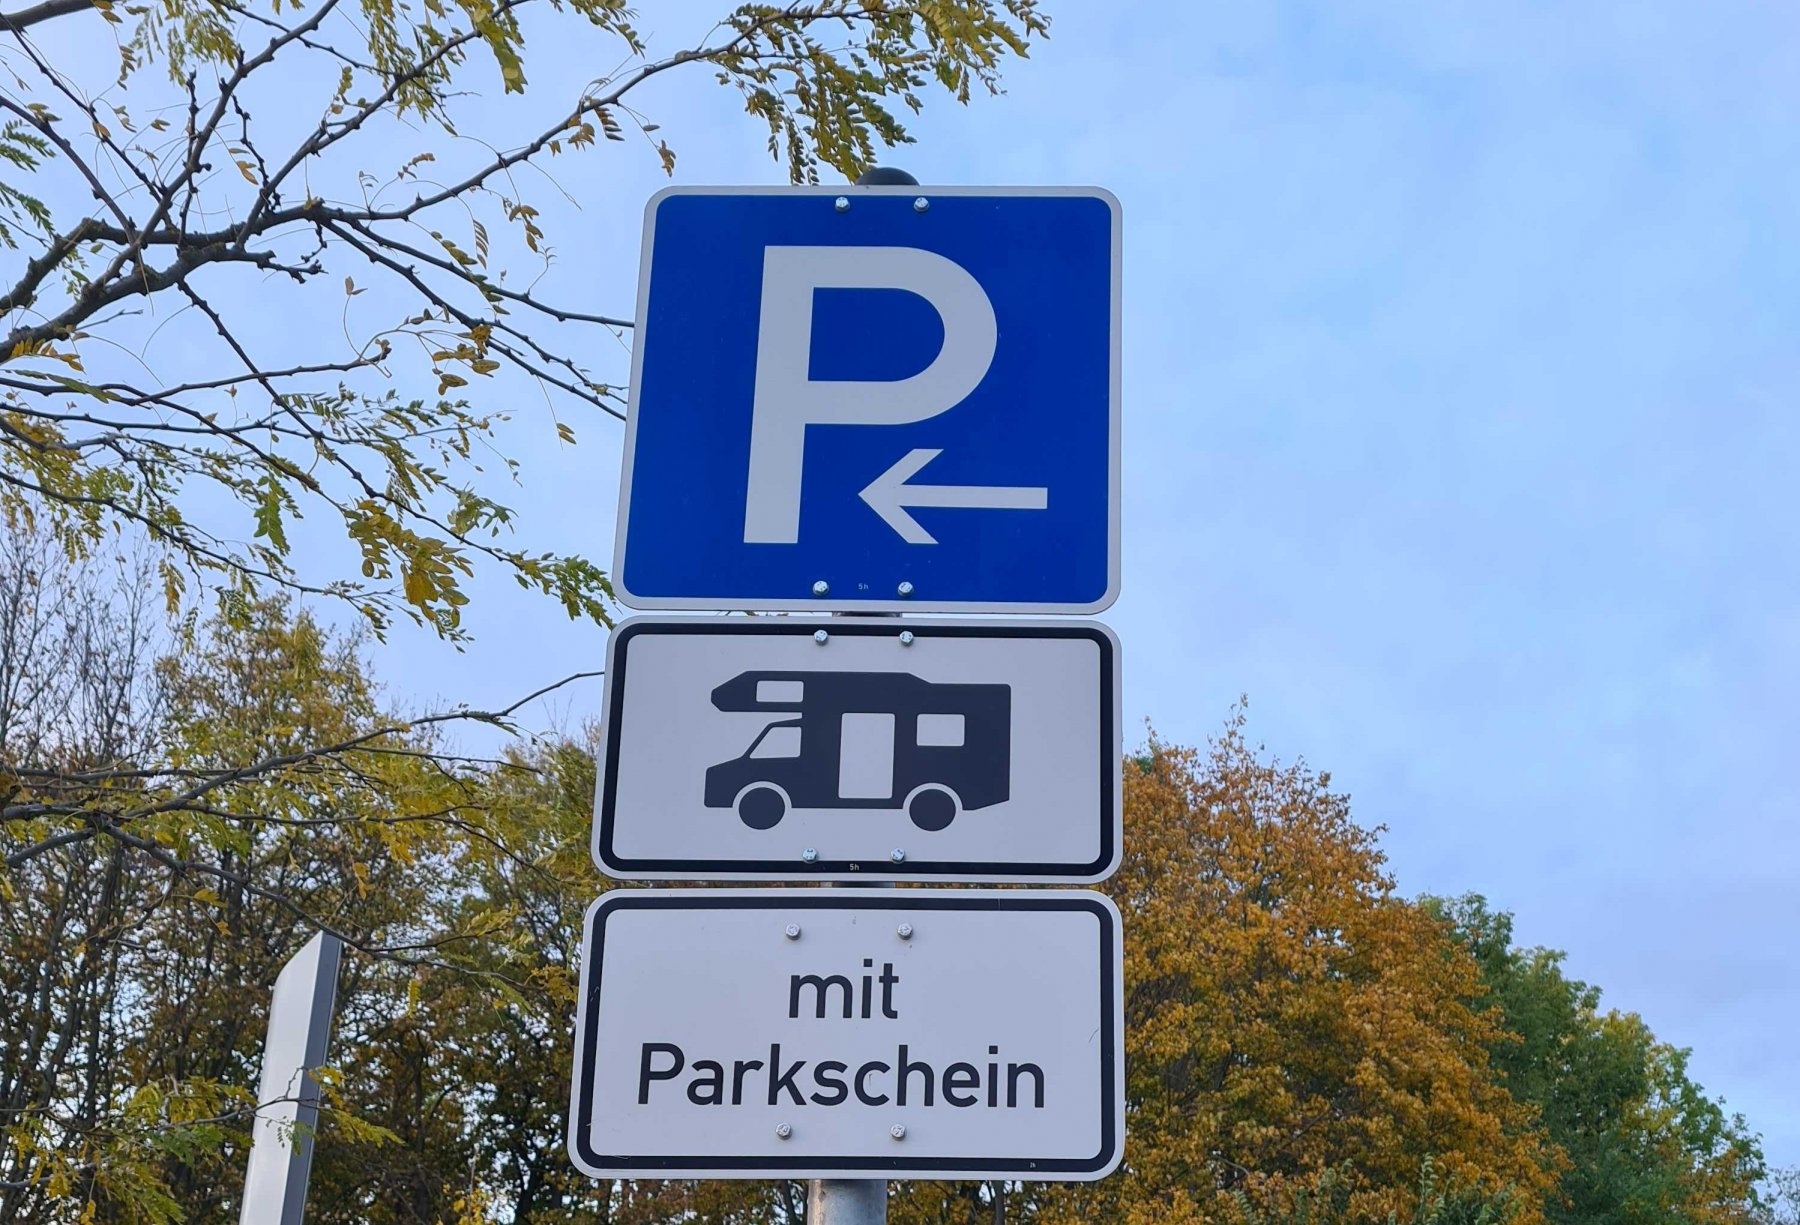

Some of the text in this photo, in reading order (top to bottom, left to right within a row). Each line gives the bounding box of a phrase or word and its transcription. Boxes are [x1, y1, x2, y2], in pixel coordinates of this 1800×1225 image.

[743, 245, 998, 544] P
[788, 958, 900, 1020] mit
[637, 1042, 1046, 1109] Parkschein
